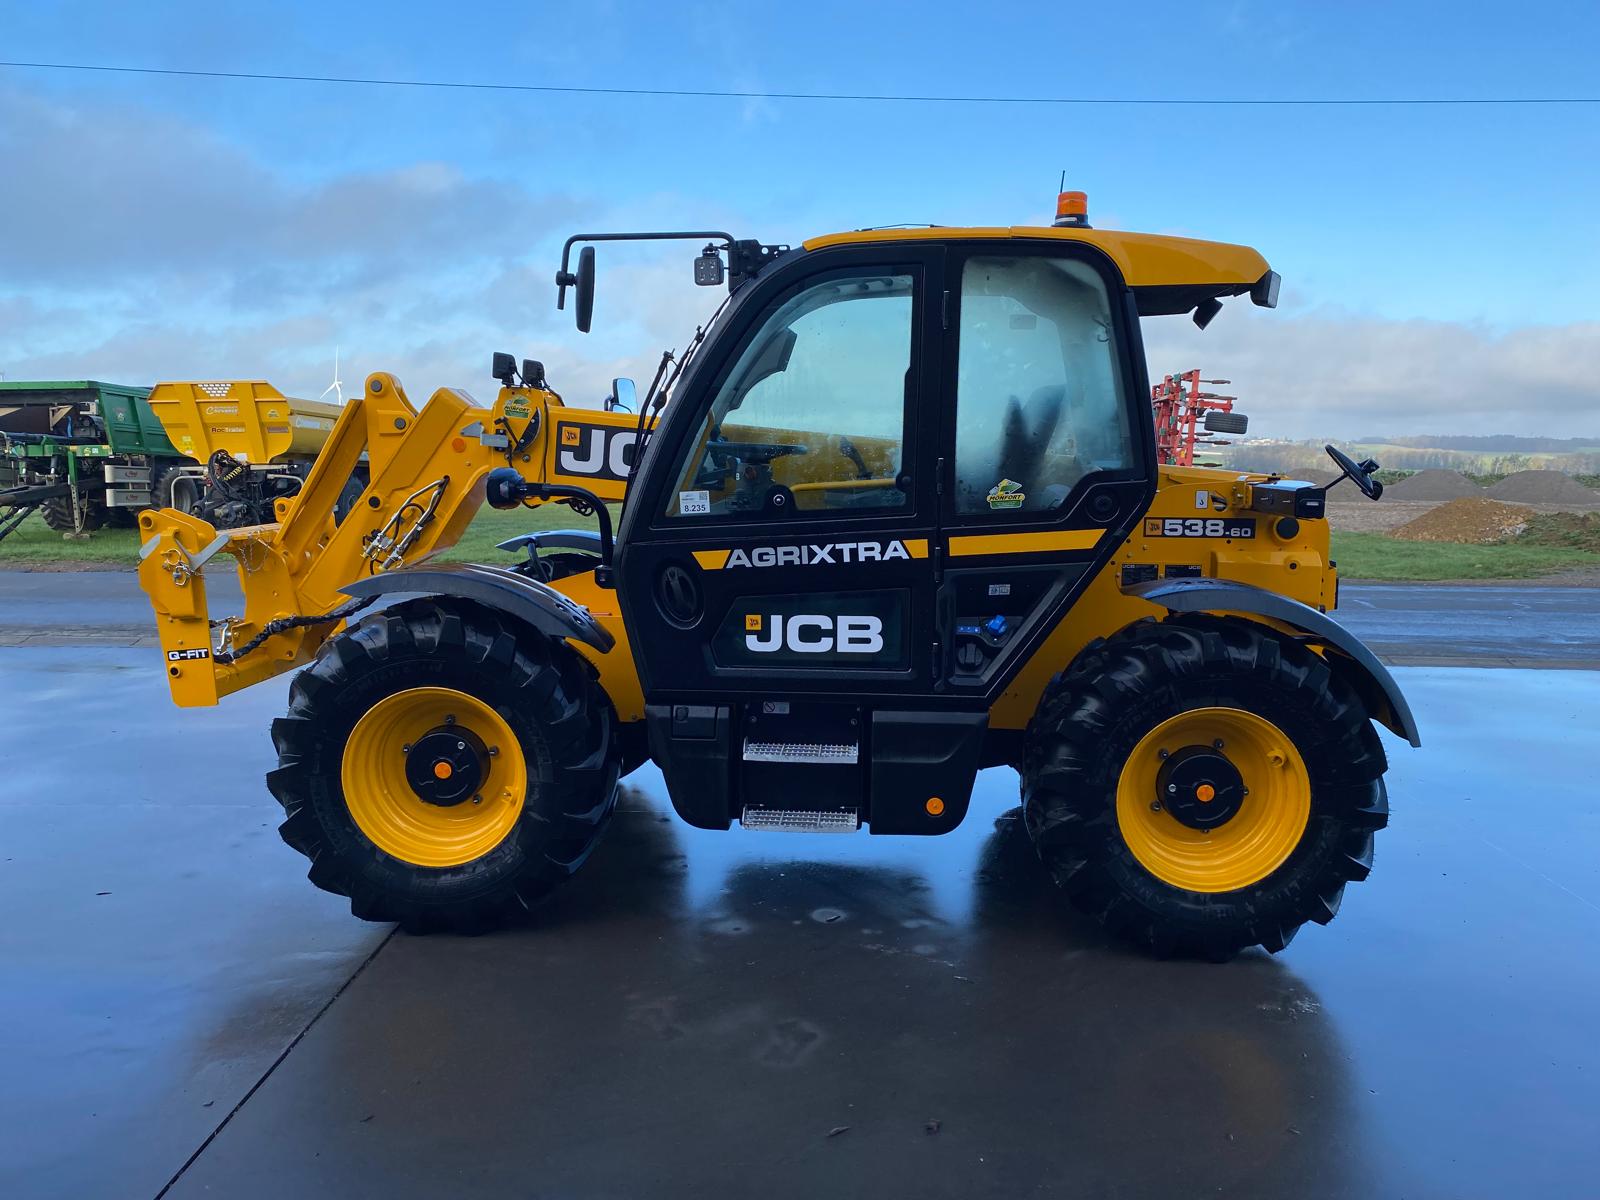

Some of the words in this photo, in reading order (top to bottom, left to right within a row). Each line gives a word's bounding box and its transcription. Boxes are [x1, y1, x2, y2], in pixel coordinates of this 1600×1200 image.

[684, 504, 706, 512] 8.235
[725, 540, 909, 569] AGRIXTRA
[745, 614, 884, 653] JCB
[168, 648, 208, 661] Q-FIT
